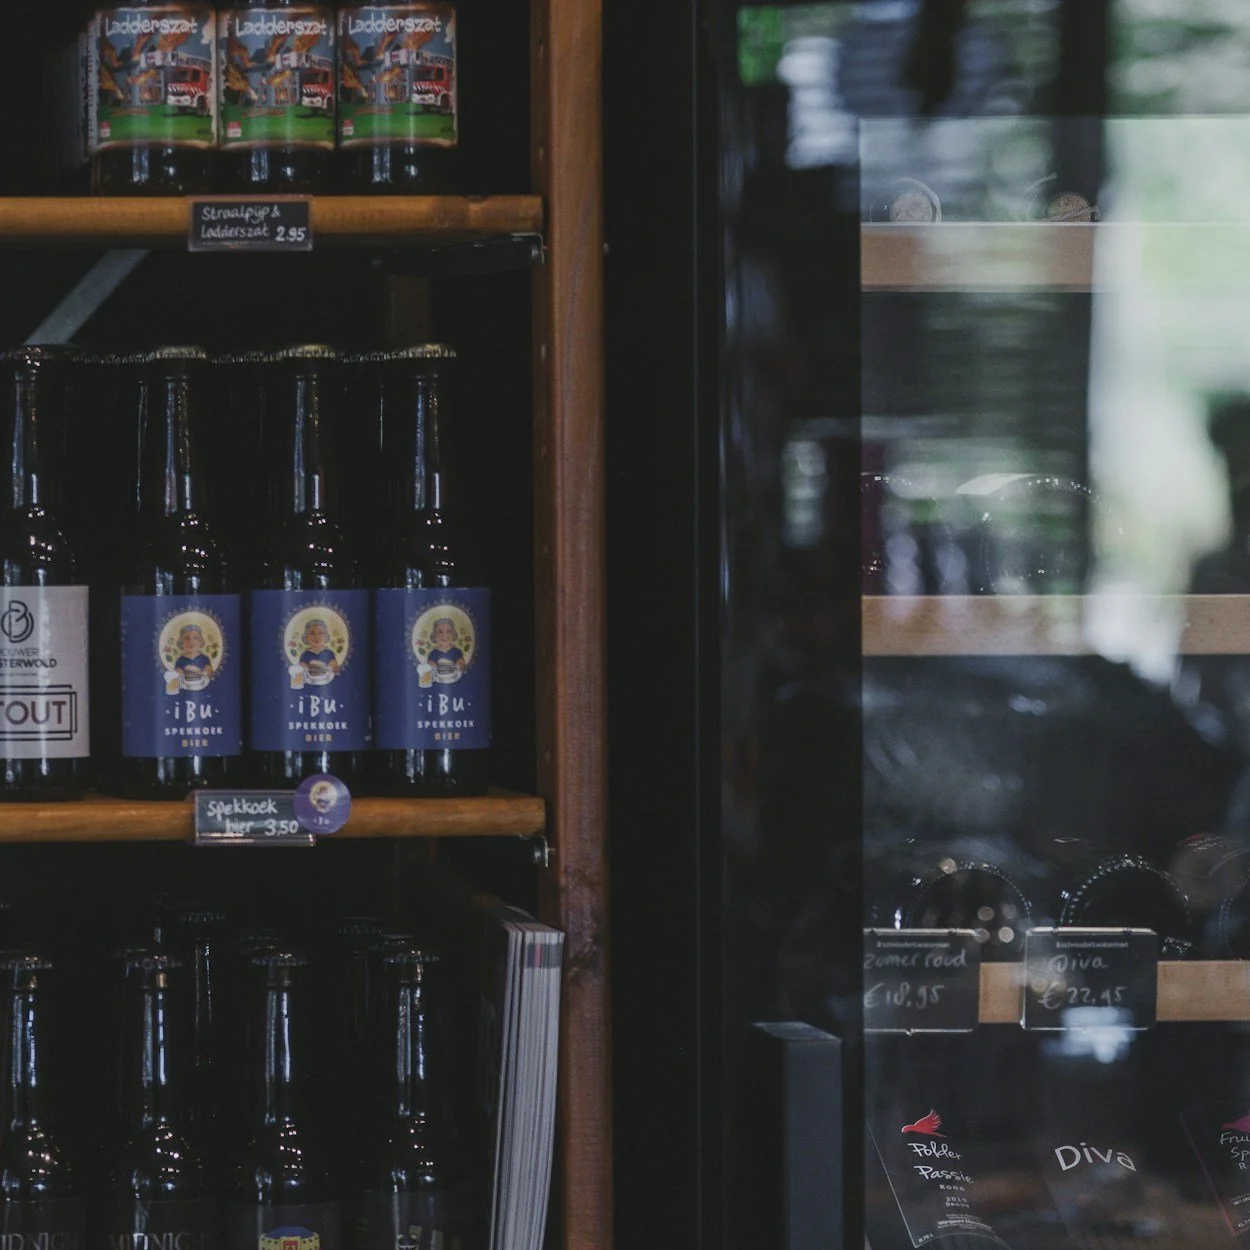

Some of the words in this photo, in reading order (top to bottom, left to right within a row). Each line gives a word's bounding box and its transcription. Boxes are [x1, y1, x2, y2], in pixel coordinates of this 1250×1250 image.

[105, 14, 198, 36] Ladderszat
[236, 16, 327, 37] Ladderszat
[349, 14, 441, 35] Ladderszat
[165, 726, 223, 741] SPEKKOEK
[287, 721, 348, 735] SPEKKOEK
[417, 719, 475, 734] SPEKKOEK
[181, 738, 209, 749] BIER
[304, 733, 333, 744] BIER
[434, 732, 461, 742] BIER
[907, 1141, 963, 1161] Polder
[1054, 1141, 1137, 1171] Diva
[913, 1165, 976, 1184] Passie
